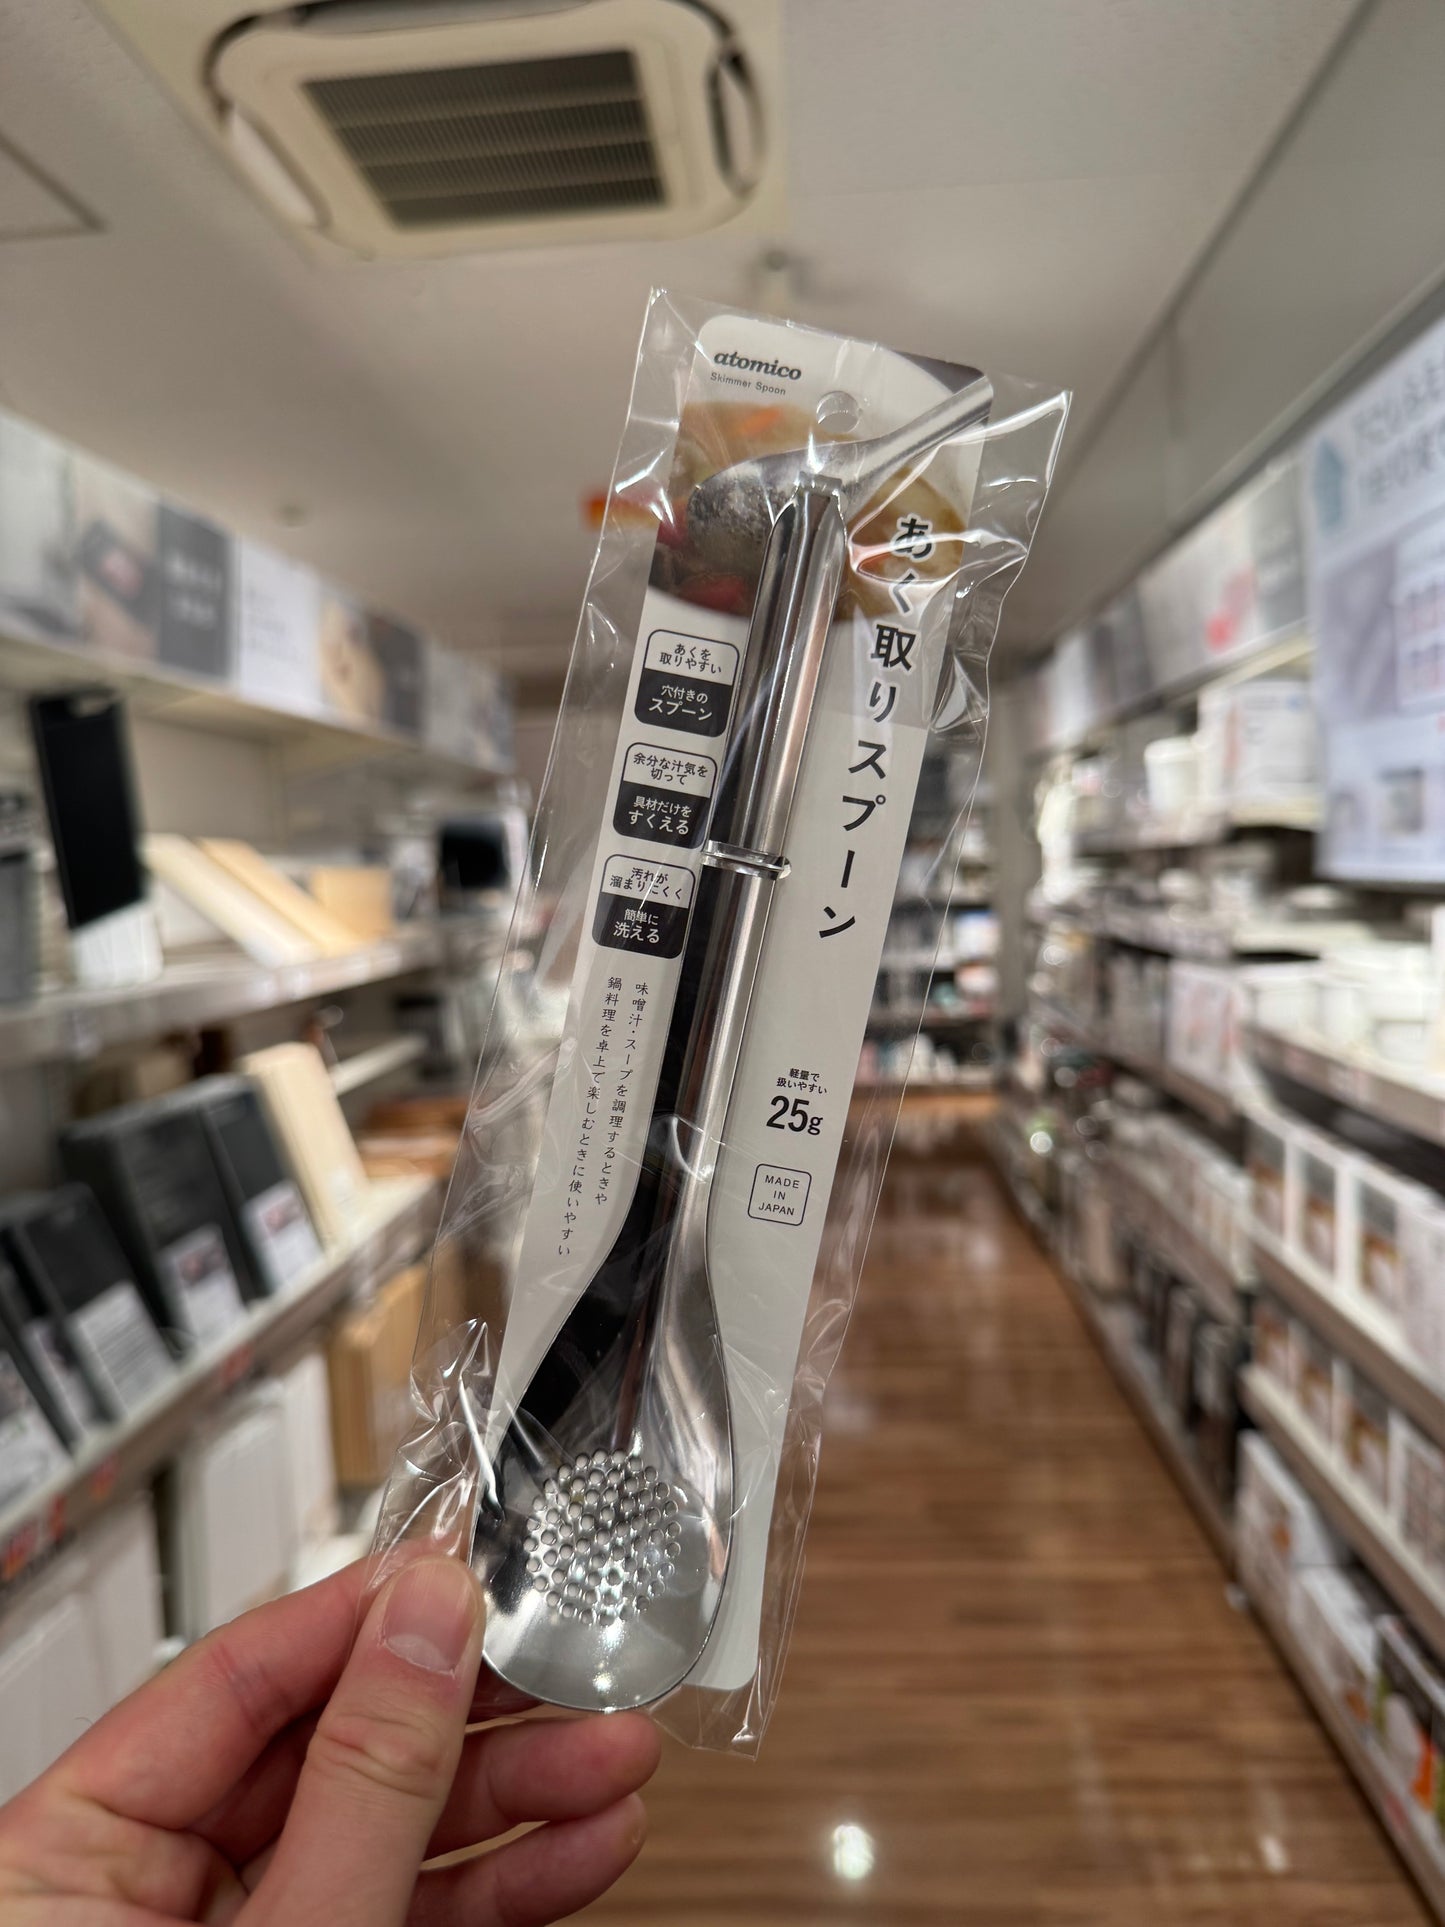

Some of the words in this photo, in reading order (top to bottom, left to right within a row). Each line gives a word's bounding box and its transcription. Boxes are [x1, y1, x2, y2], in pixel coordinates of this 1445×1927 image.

[713, 350, 802, 381] atomico
[710, 371, 752, 390] Skimmer
[755, 380, 786, 396] Spoon
[674, 643, 712, 660] あくを
[659, 652, 722, 675] 取りやすい
[661, 684, 708, 704] 穴付きの
[648, 698, 712, 721] スプーン
[818, 517, 933, 938] あく取りスプーン
[633, 752, 709, 778] 余分な汁気を
[650, 767, 688, 785] 切って
[633, 795, 692, 818] 具材だけを
[628, 809, 690, 835] すくえる
[631, 867, 668, 883] 汚れが
[610, 875, 682, 900] 溜まりにくく
[624, 908, 659, 926] 簡単に
[613, 920, 660, 944] 洗える
[776, 1077, 827, 1094] 扱いやすい
[789, 1068, 820, 1083] 軽量で
[766, 1095, 823, 1136] 25g
[765, 1174, 800, 1189] MADE
[773, 1190, 786, 1200] IN
[758, 1202, 795, 1216] JAPAN
